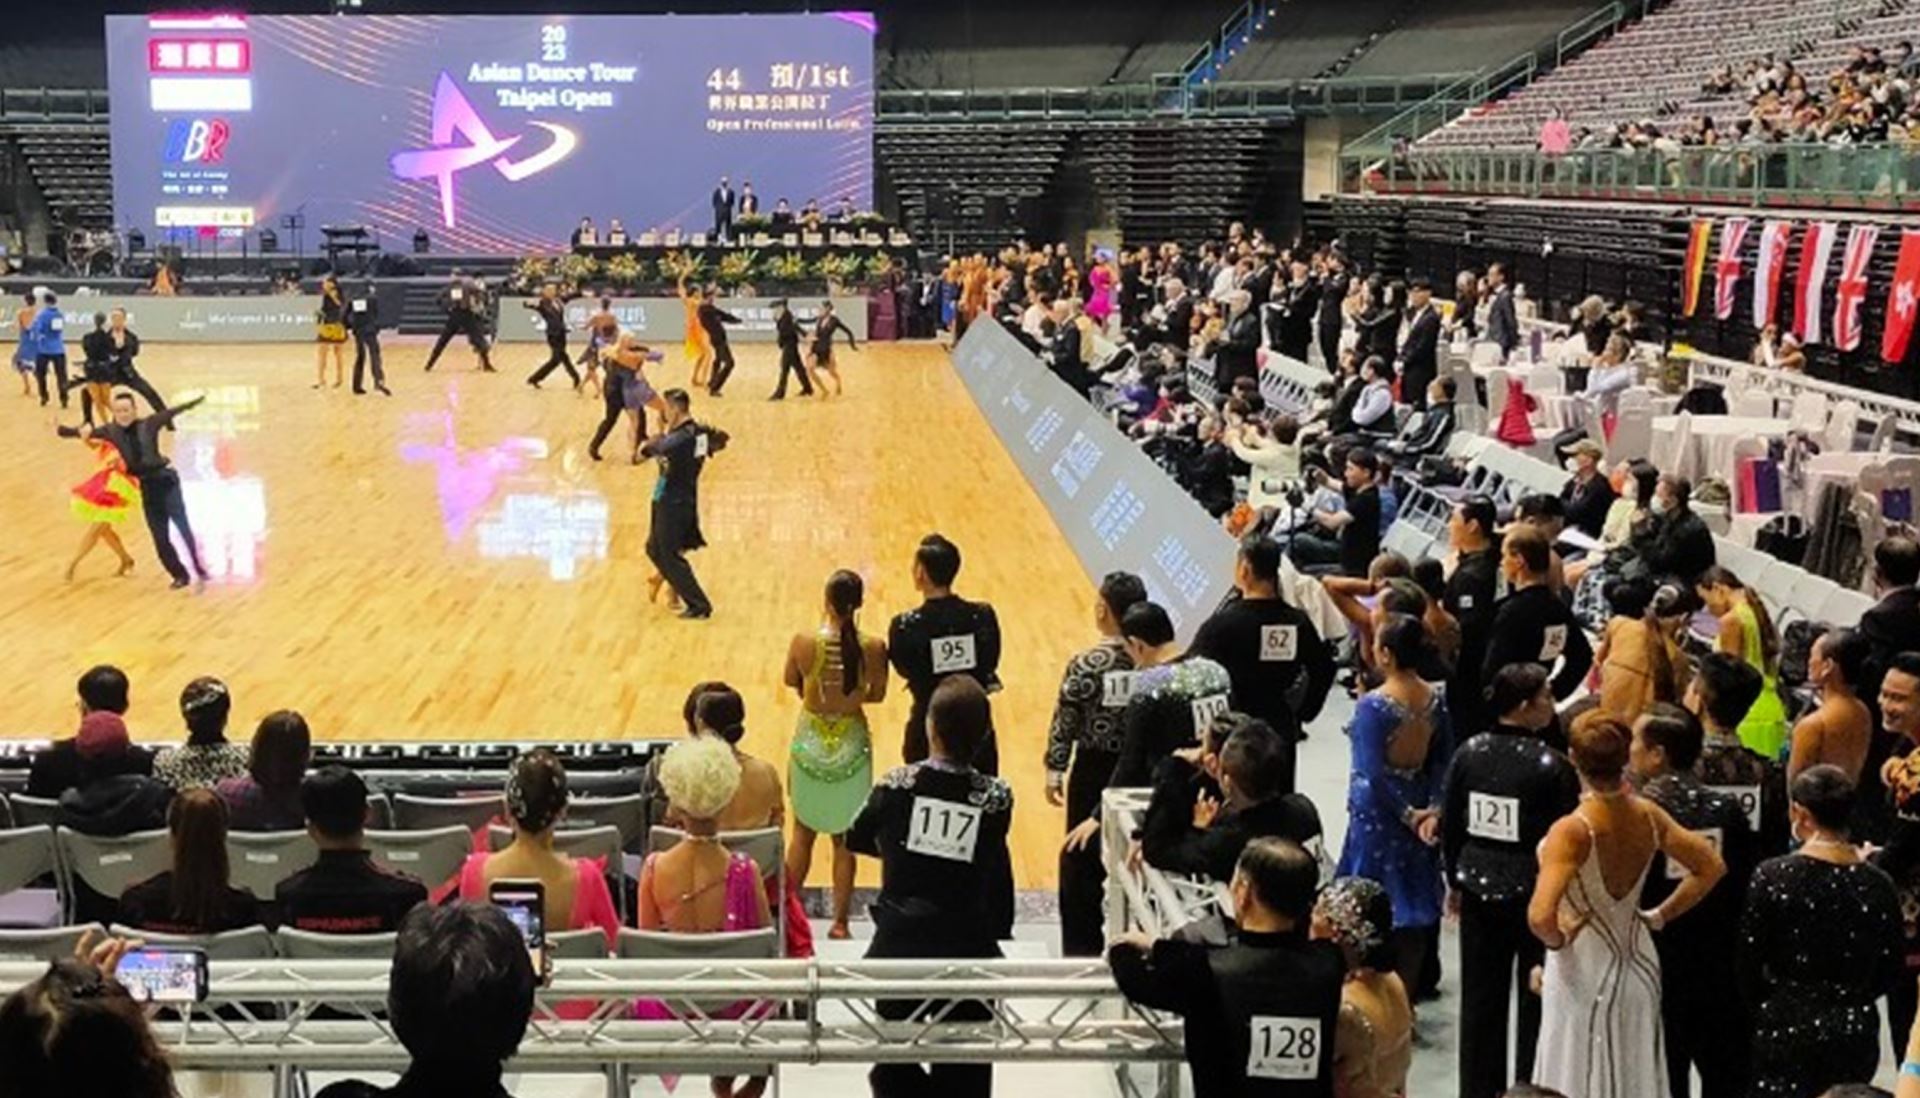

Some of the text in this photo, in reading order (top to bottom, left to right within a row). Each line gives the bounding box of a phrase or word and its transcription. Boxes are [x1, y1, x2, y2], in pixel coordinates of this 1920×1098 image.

[541, 25, 567, 43] 20
[541, 43, 567, 61] 23
[468, 63, 637, 82] Asian Dance Tour
[706, 68, 741, 91] 44
[497, 87, 613, 111] Taipei Open
[706, 118, 740, 132] Open
[1267, 629, 1289, 649] 62
[940, 640, 965, 661] 95
[920, 806, 975, 841] 117
[1473, 800, 1511, 827] 121
[1260, 1024, 1316, 1059] 128
